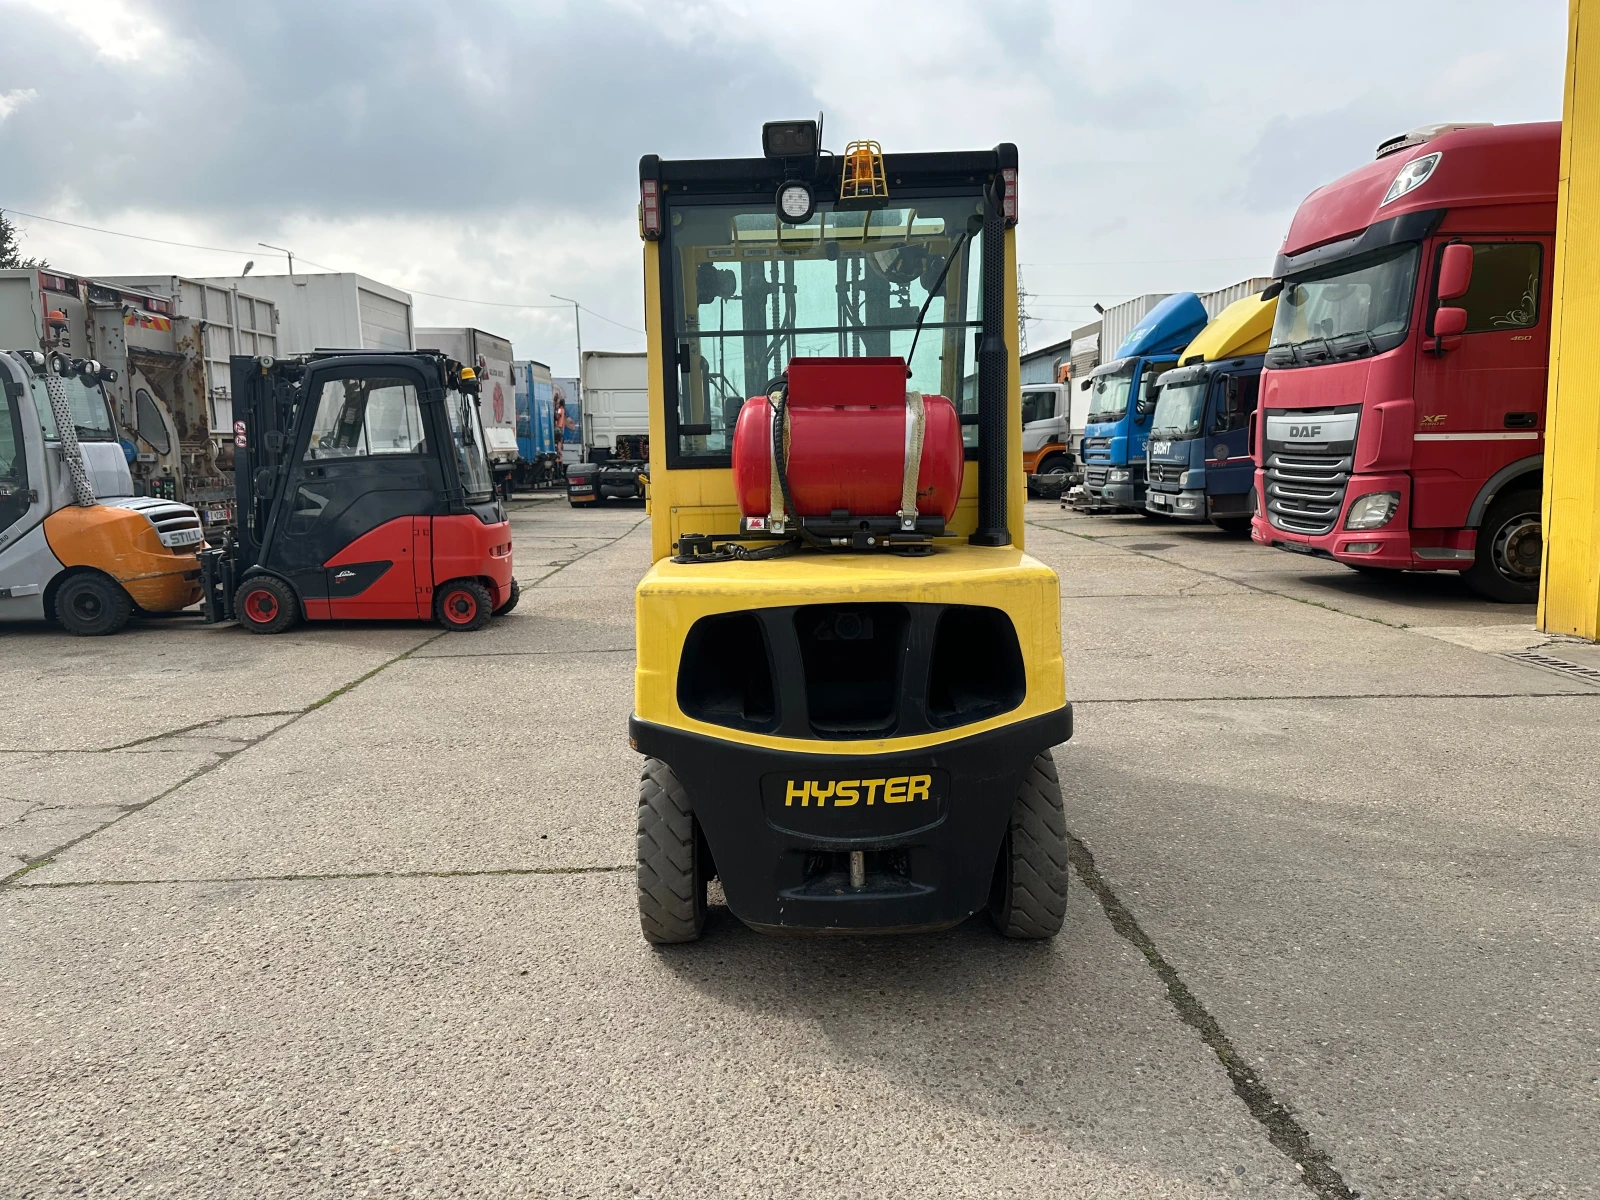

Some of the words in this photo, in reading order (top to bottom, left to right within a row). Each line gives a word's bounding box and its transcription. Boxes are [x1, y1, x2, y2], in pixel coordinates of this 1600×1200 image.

[1421, 414, 1448, 422] XF
[1289, 425, 1322, 438] DAF
[169, 530, 200, 545] STILL
[784, 774, 932, 807] HYSTER
